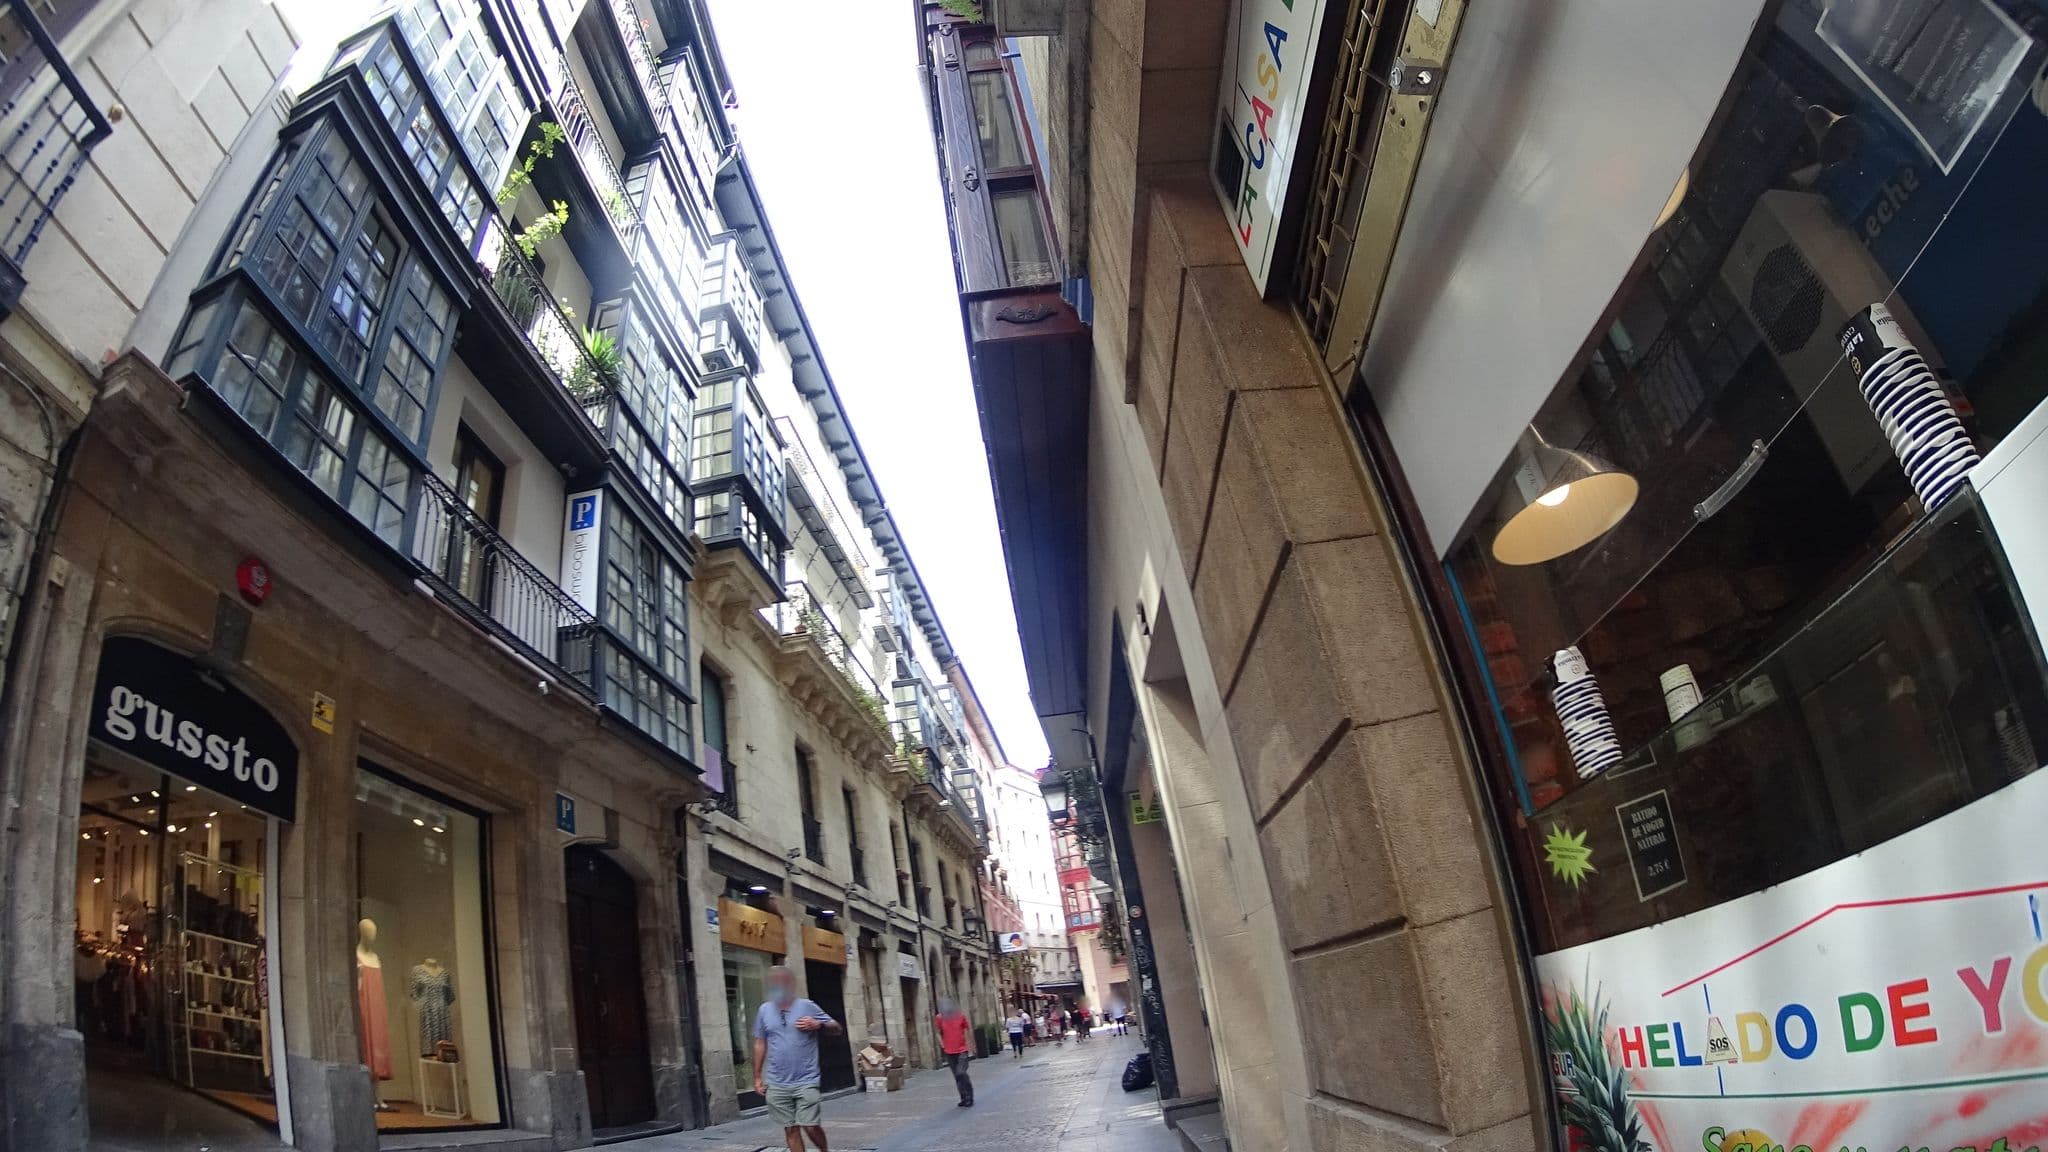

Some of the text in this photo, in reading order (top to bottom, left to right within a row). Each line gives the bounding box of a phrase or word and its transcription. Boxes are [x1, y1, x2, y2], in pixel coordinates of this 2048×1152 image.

[1236, 21, 1288, 248] LA CASA
[1864, 167, 1919, 245] eche
[575, 502, 592, 523] P
[105, 685, 280, 792] gussto
[1630, 805, 1658, 823] BATIDO
[1631, 827, 1642, 838] DE
[1636, 831, 1667, 851] NATURAL
[1838, 978, 1938, 1053] DE
[1709, 1037, 1729, 1050] SOS
